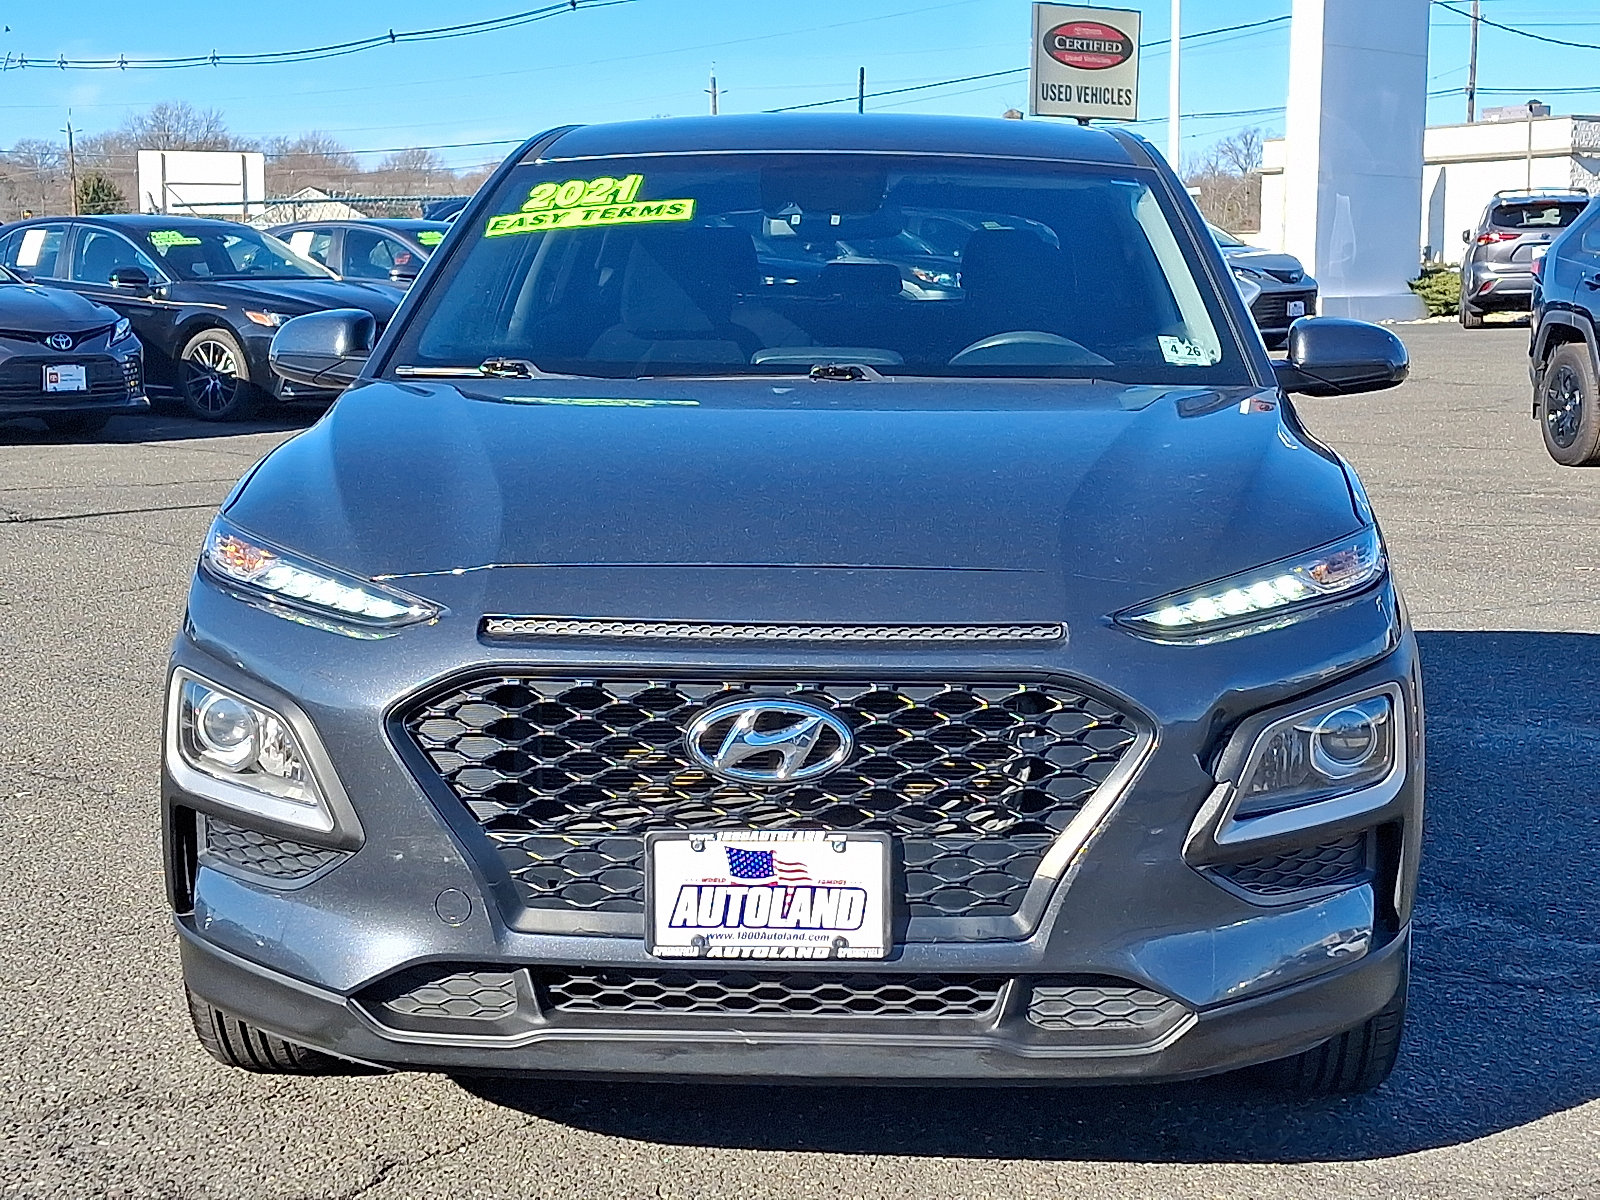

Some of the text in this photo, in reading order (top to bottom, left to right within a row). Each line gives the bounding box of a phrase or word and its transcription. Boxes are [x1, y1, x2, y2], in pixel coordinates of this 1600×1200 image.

[1054, 35, 1123, 53] CERTIFIED
[1041, 82, 1132, 106] USED VEHICLES
[521, 174, 645, 212] 2021
[490, 203, 687, 232] EASY TERMS
[1170, 344, 1201, 356] 4 26
[668, 884, 868, 930] AUTOLAND
[706, 931, 830, 942] www.1800Autoland.com
[706, 945, 831, 959] AUTOLAND
